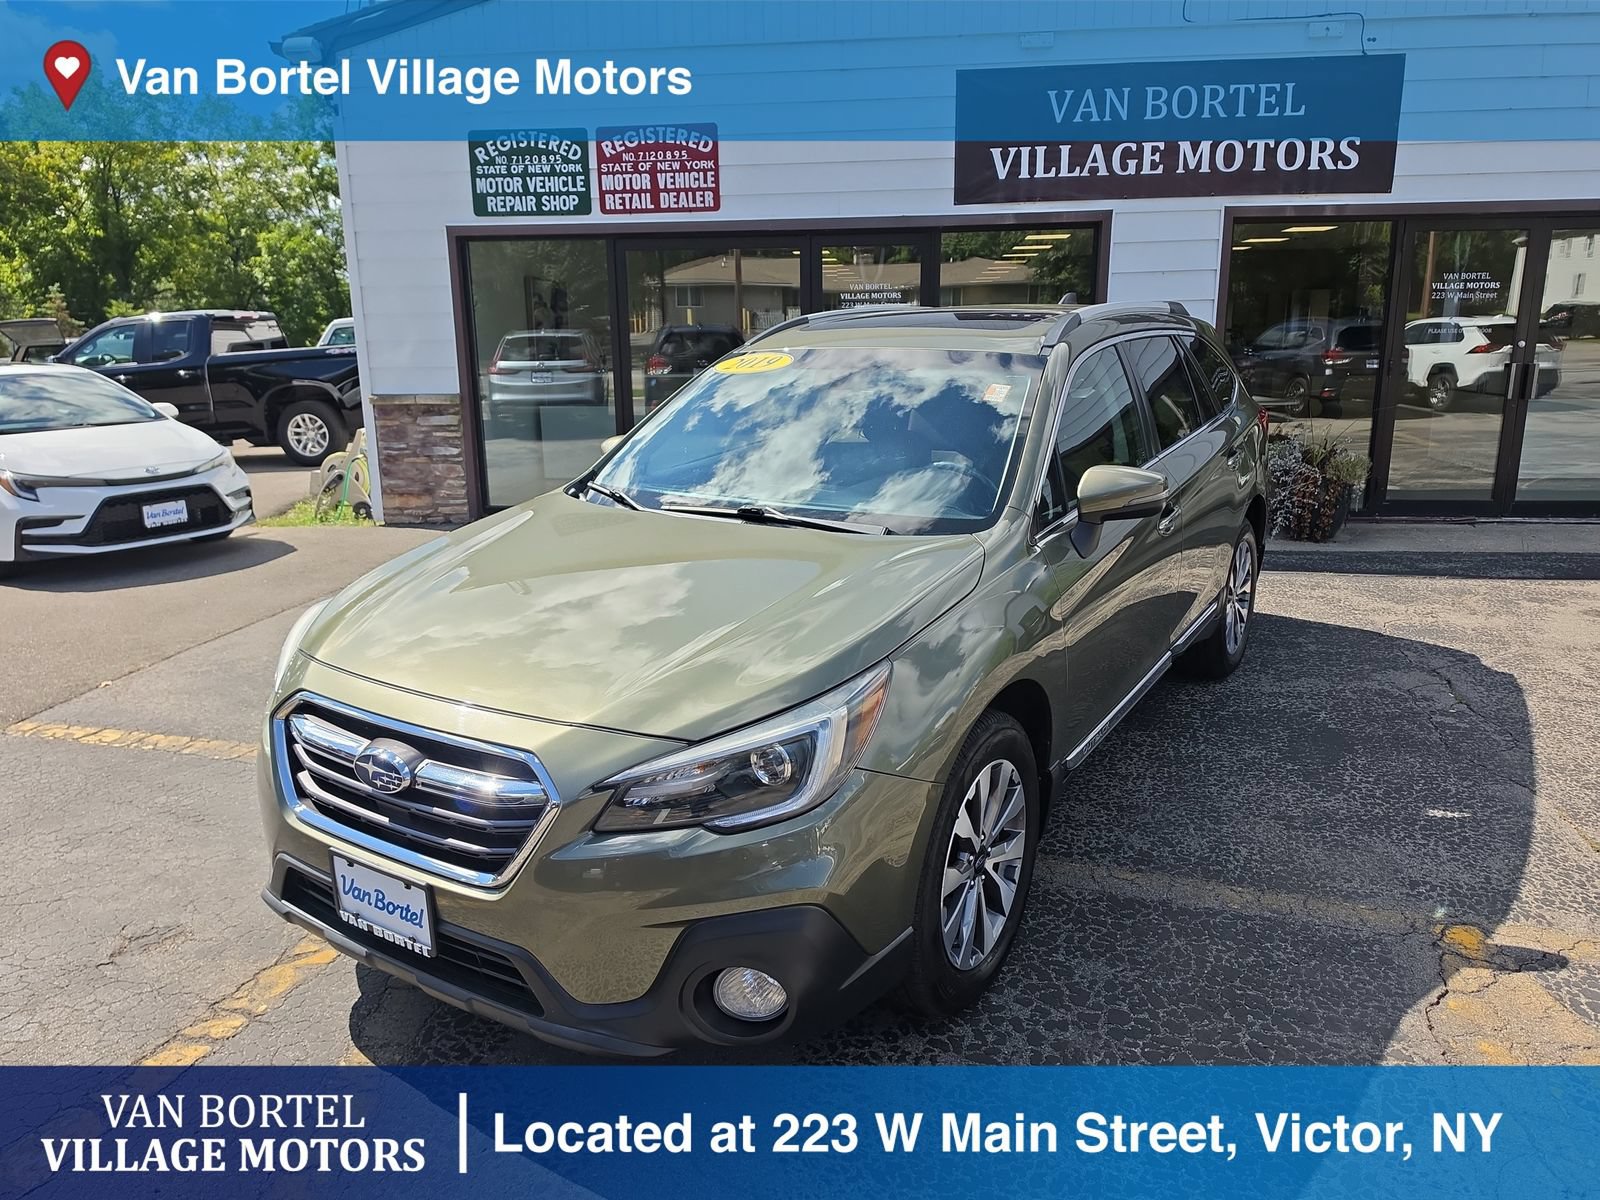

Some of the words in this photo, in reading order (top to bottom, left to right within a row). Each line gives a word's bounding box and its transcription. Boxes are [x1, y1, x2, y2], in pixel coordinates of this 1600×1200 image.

[1048, 88, 1130, 123] VAN
[1144, 82, 1306, 121] BORTEL
[474, 131, 582, 163] REGISTERED
[600, 127, 714, 158] REGISTERED
[511, 154, 562, 164] 7120895
[637, 150, 688, 160] 7120895
[990, 141, 1165, 180] VILLAGE
[1176, 136, 1361, 174] MOTORS
[476, 165, 507, 174] STATE
[510, 165, 525, 174] OF
[528, 164, 550, 173] NEW
[554, 163, 583, 173] YORK
[600, 162, 634, 172] STATE
[638, 162, 653, 171] OF
[657, 161, 680, 170] NEW
[685, 160, 715, 169] YORK
[475, 177, 523, 193] MOTOR
[526, 175, 586, 192] VEHICLE
[601, 173, 651, 190] MOTOR
[656, 171, 716, 189] VEHICLE
[487, 195, 537, 212] REPAIR
[541, 194, 579, 211] SHOP
[604, 192, 655, 210] RETAIL
[659, 191, 714, 208] DEALER
[1443, 272, 1460, 280] VAN
[1461, 272, 1491, 280] BORTEL
[1431, 282, 1465, 290] VILLAGE
[1466, 281, 1501, 289] MOTORS
[840, 292, 870, 300] VILLAGE
[1431, 291, 1446, 299] 223
[1447, 291, 1455, 299] W
[1457, 291, 1474, 299] Main
[1475, 291, 1498, 299] Street
[340, 910, 369, 932] VAN
[372, 924, 432, 958] BORTEL
